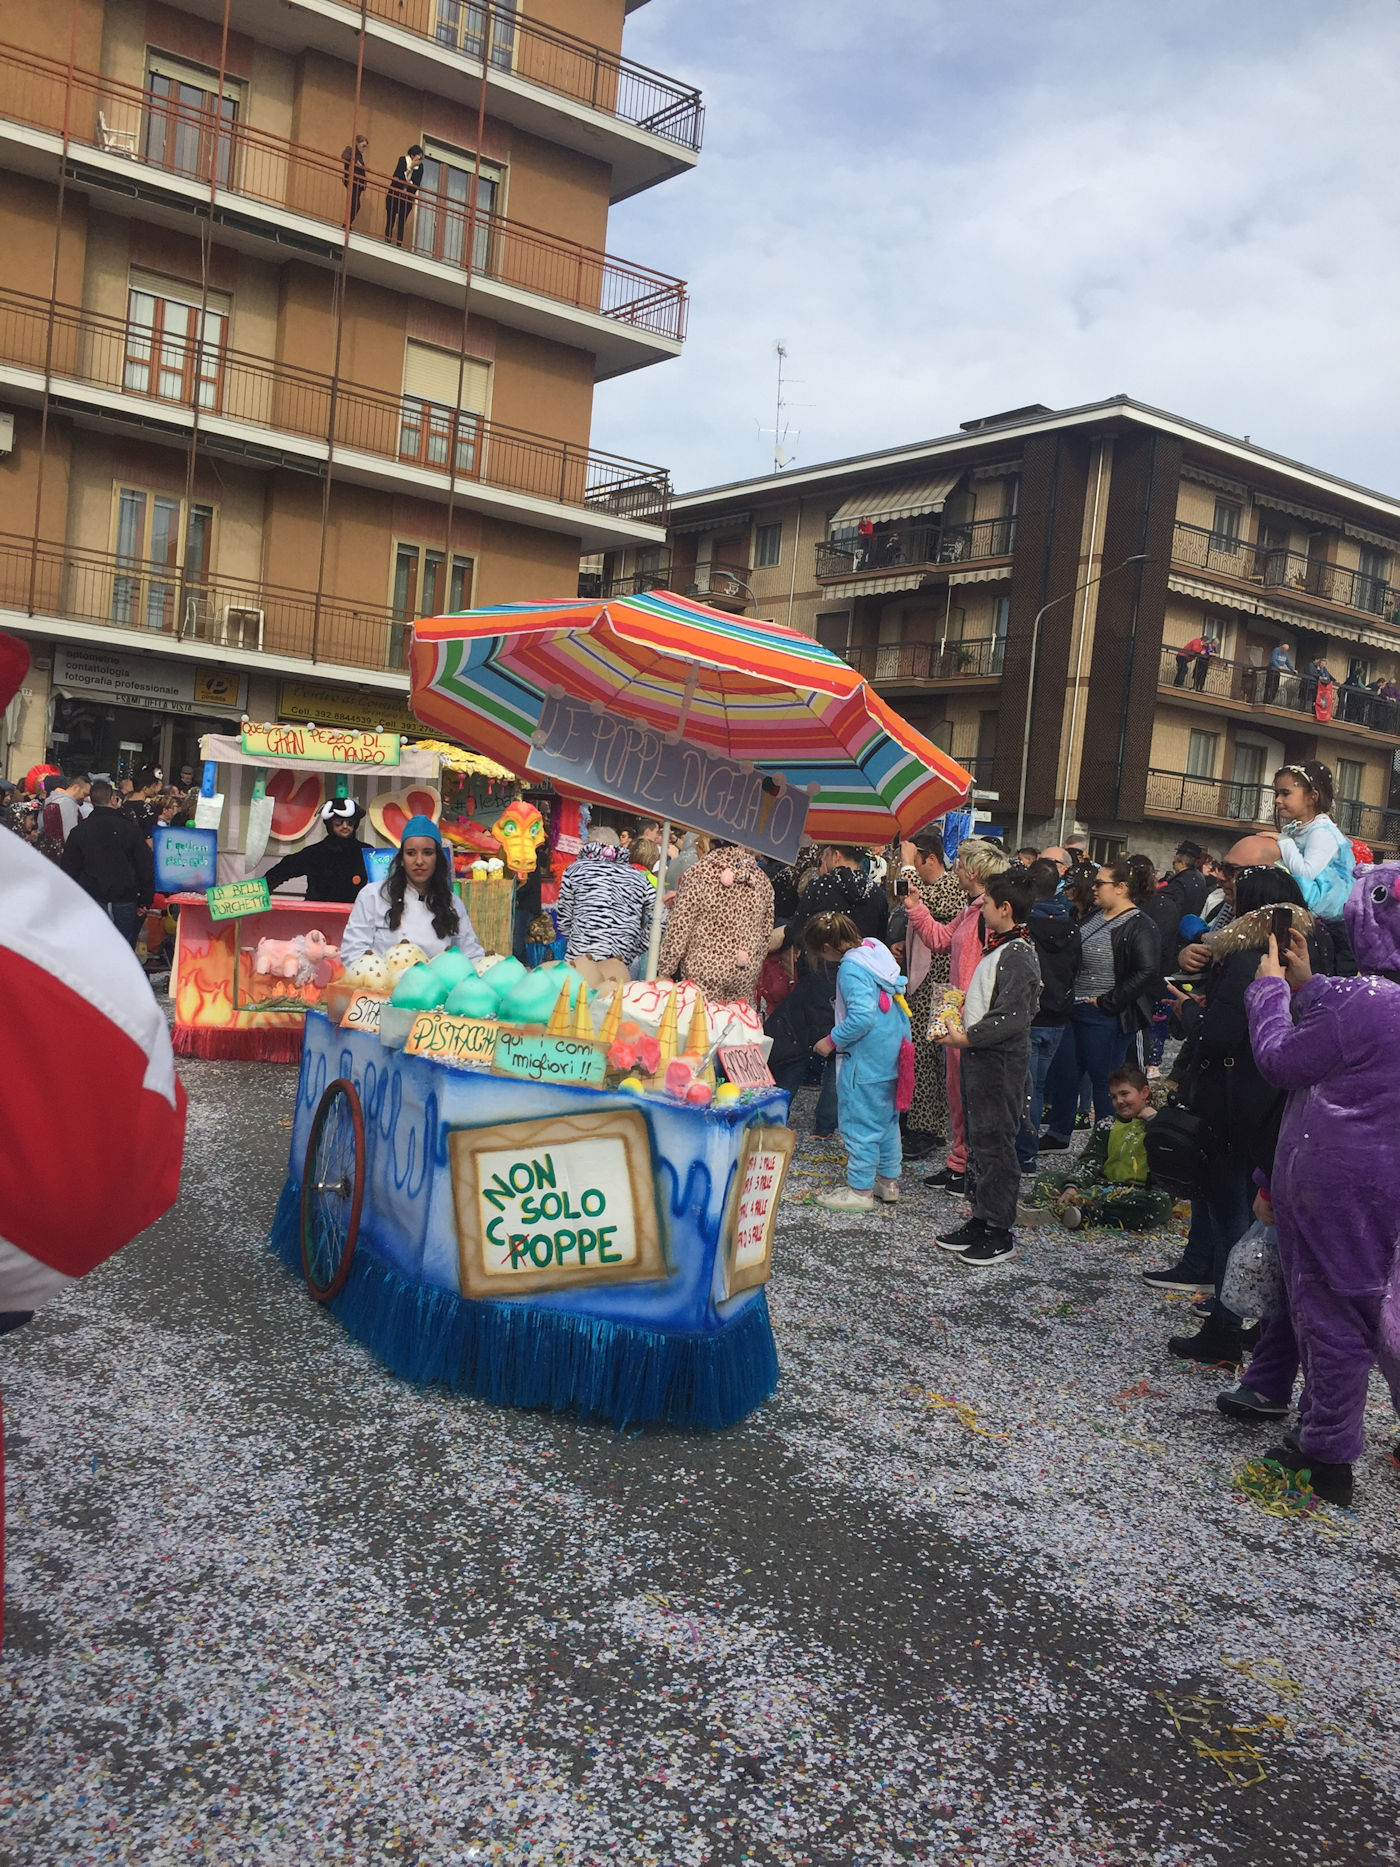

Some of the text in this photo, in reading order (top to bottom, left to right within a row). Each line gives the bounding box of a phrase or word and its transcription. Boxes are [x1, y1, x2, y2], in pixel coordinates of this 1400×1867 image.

[66, 661, 130, 678] contattologia
[65, 672, 179, 696] fotografia professionale
[115, 695, 193, 712] ESAMI DELLA VISTA
[315, 710, 332, 719] 392
[334, 712, 372, 724] 8844539
[401, 722, 417, 731] 393
[242, 722, 269, 736] QUEL
[267, 727, 305, 755] GRAN
[309, 729, 354, 745] PEZZO
[332, 745, 386, 765] MANZO
[541, 702, 587, 763] LE
[585, 713, 667, 802] POPPE
[212, 880, 265, 901] LA BELLA
[500, 1032, 524, 1056] qui
[511, 1053, 574, 1080] migliori
[481, 1153, 557, 1212] NON
[520, 1188, 606, 1225] SOLO
